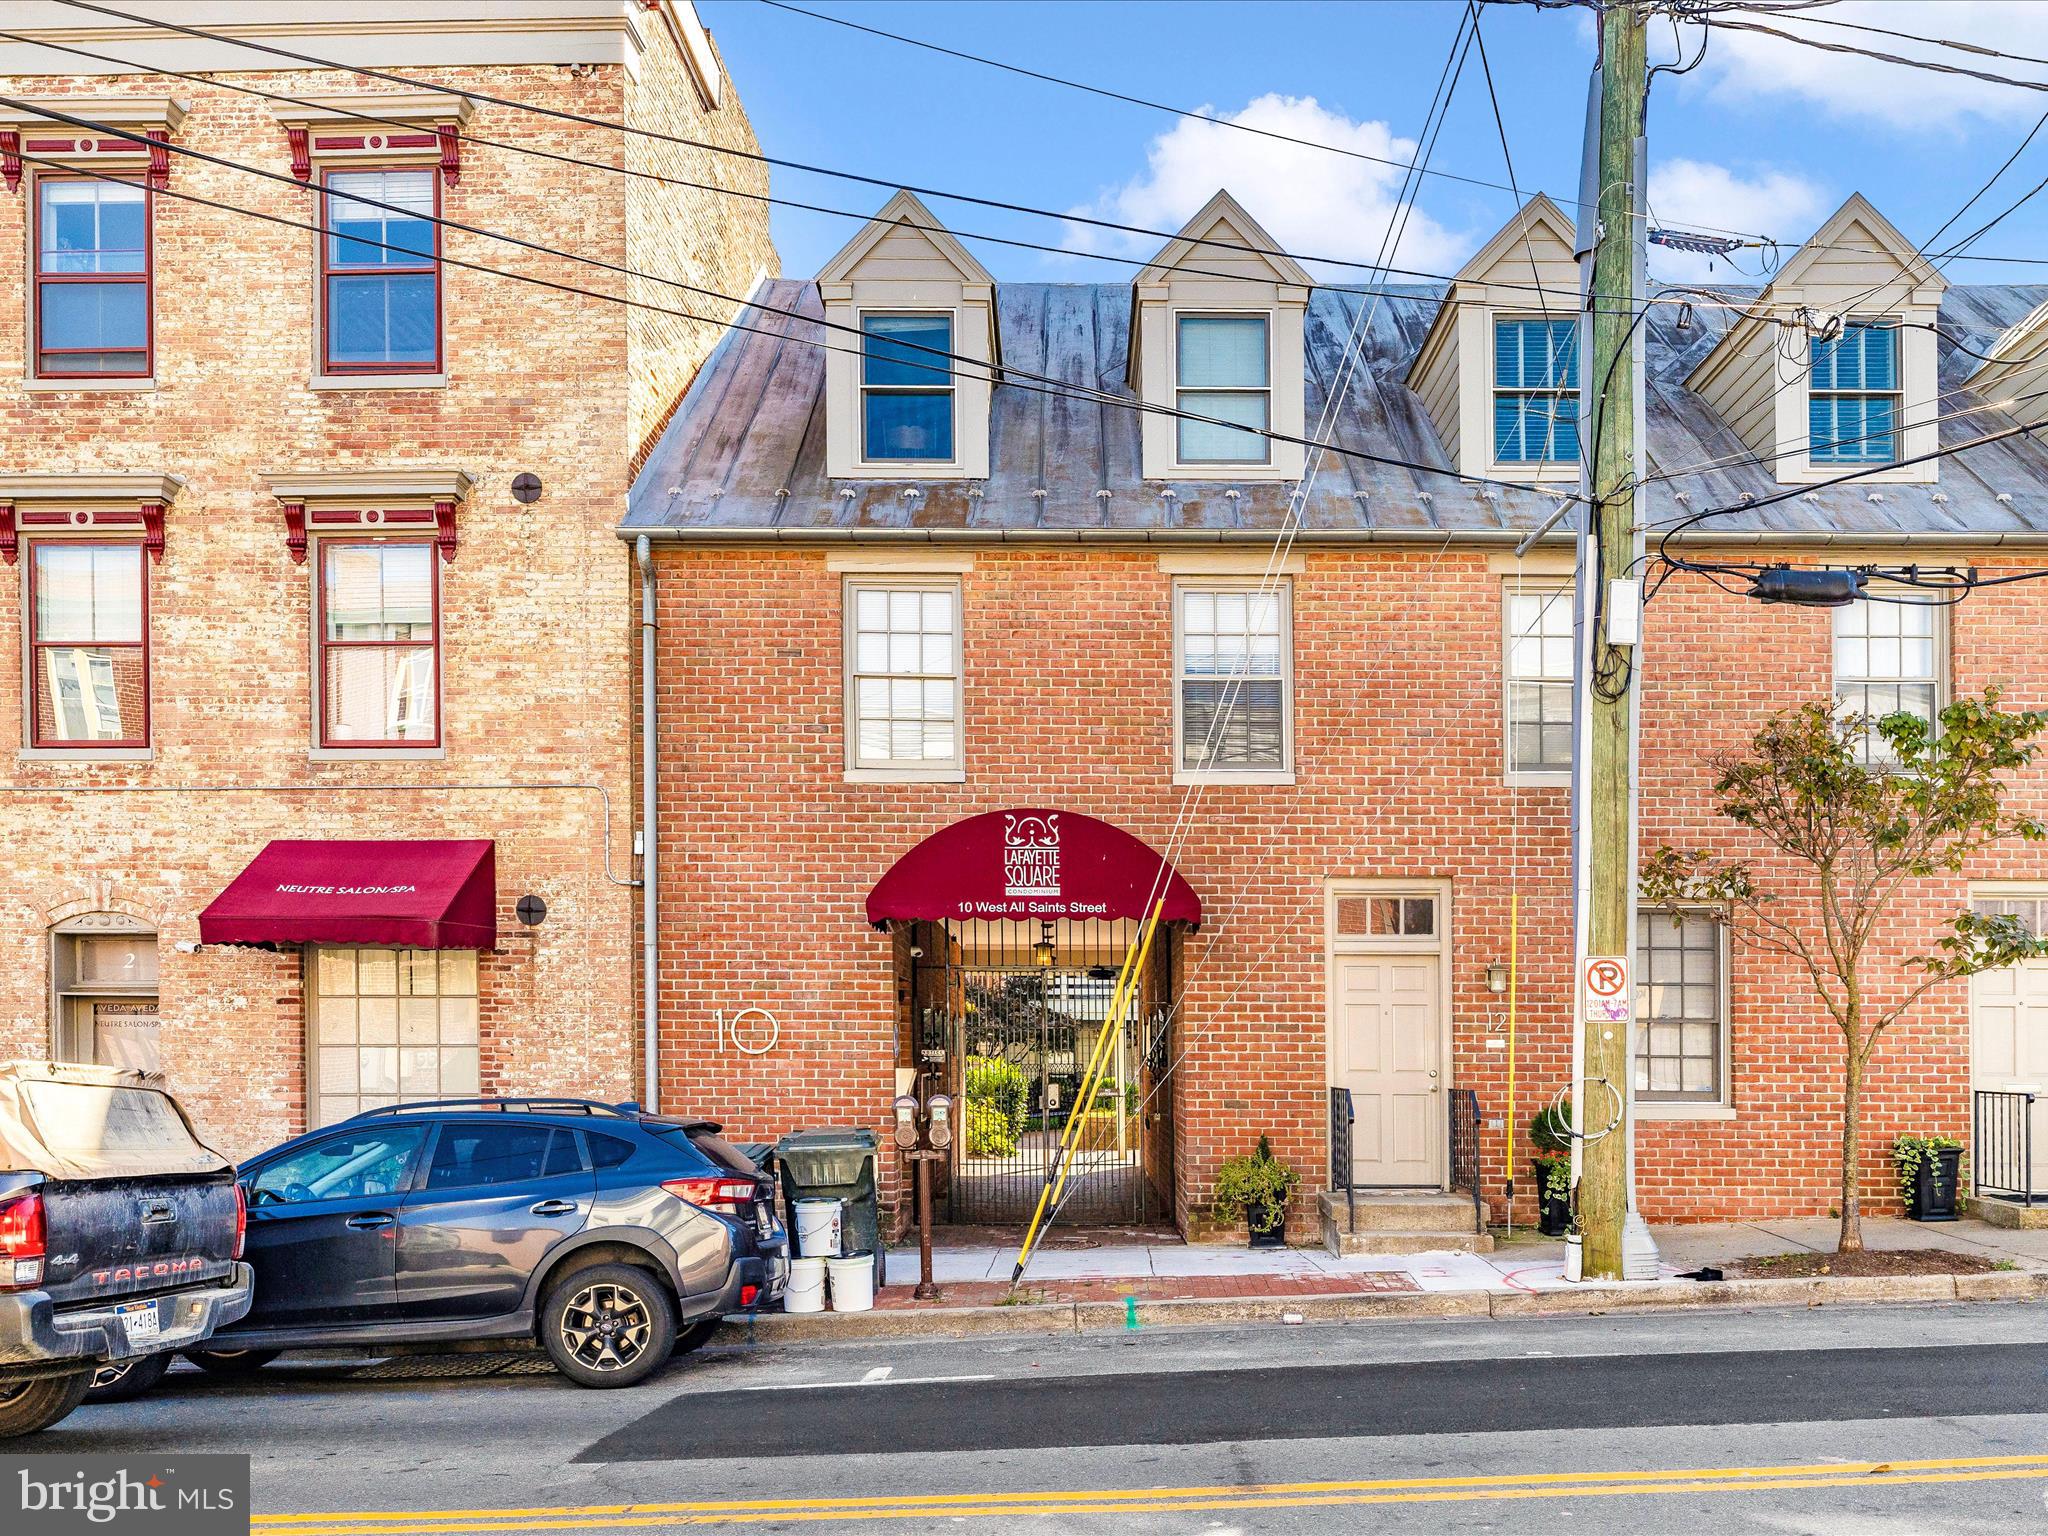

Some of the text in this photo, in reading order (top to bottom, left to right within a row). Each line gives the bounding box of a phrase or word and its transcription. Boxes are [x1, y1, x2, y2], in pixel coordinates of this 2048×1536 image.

[1004, 849, 1060, 865] LAFAYETTE
[1005, 866, 1061, 886] SQUARE
[276, 884, 416, 895] NEUTRE SALON/SPA
[958, 901, 1107, 913] 10 West All Saints Street
[123, 953, 136, 969] 2
[96, 1004, 128, 1012] AVEDA
[1487, 1011, 1507, 1032] 12
[715, 1007, 779, 1055] 10
[92, 1258, 203, 1285] TACOMA
